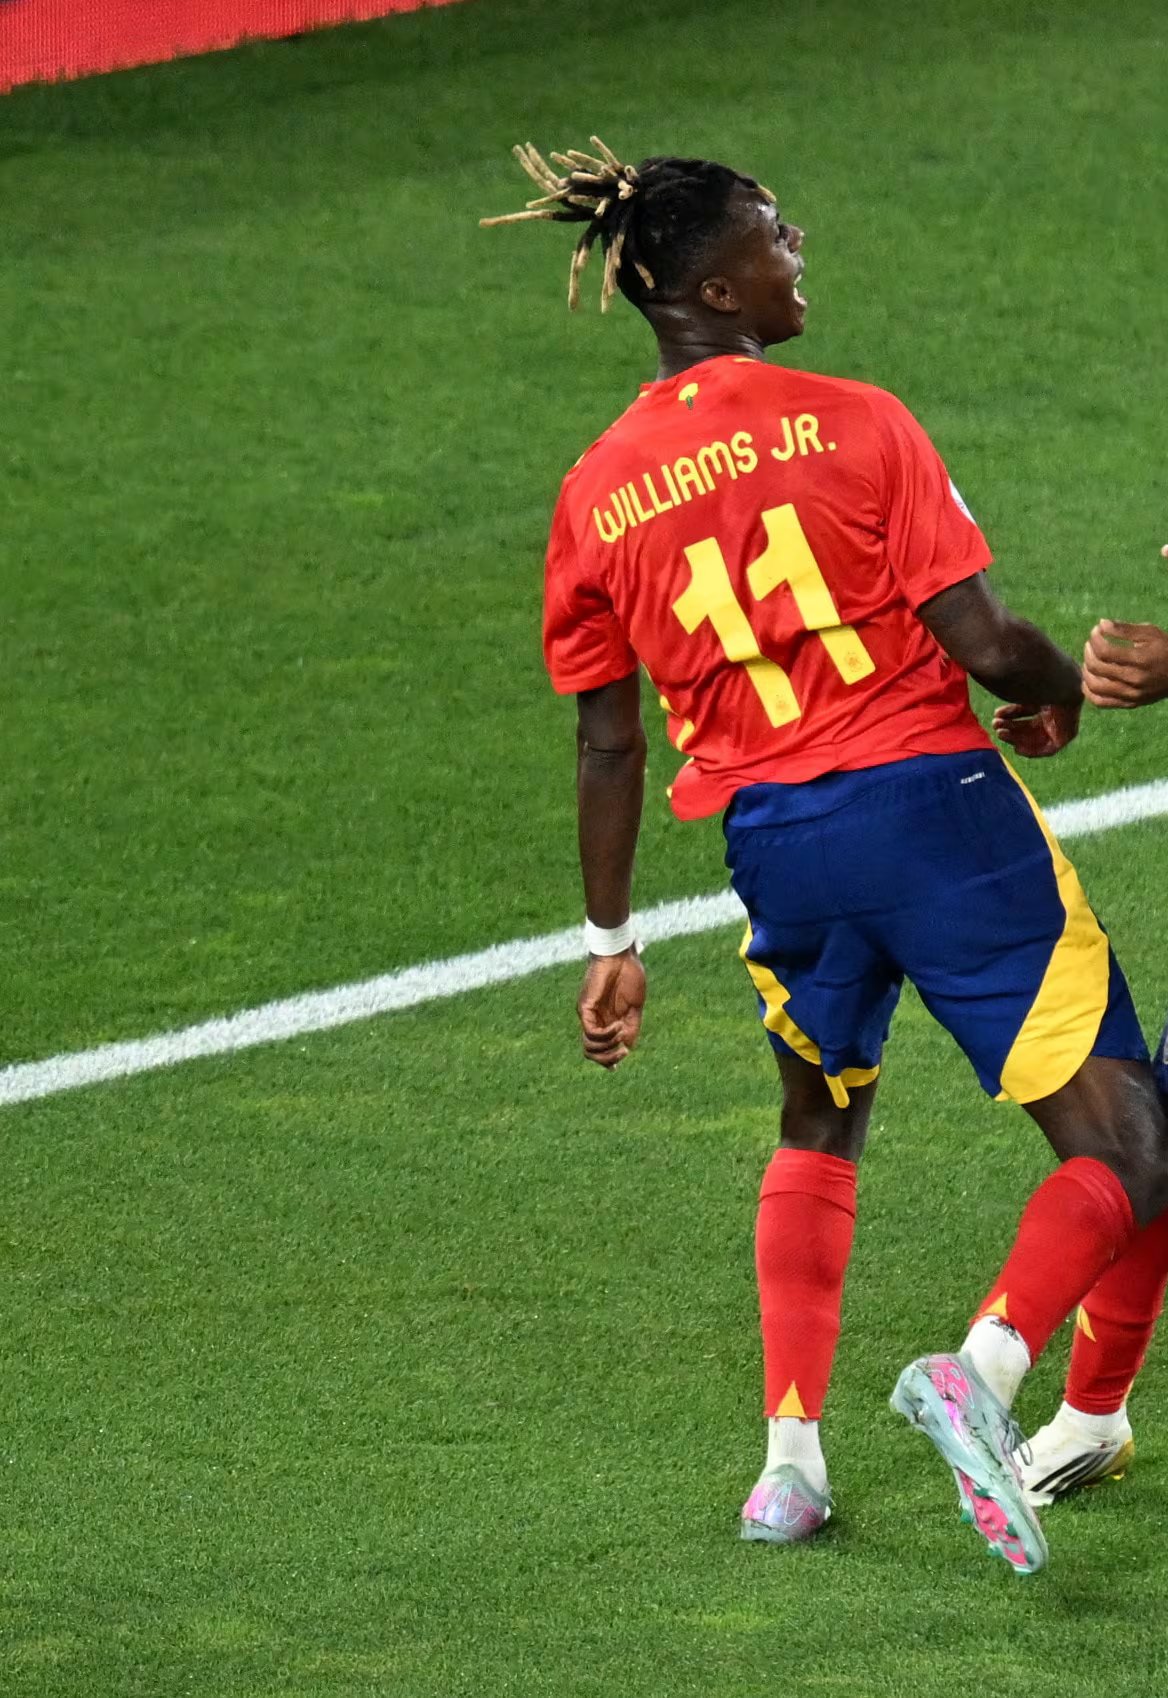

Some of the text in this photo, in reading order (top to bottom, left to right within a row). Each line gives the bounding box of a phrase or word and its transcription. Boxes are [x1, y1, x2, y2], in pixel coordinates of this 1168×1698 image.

[593, 413, 837, 543] WILLIAMS JR.
[672, 503, 876, 729] 11
